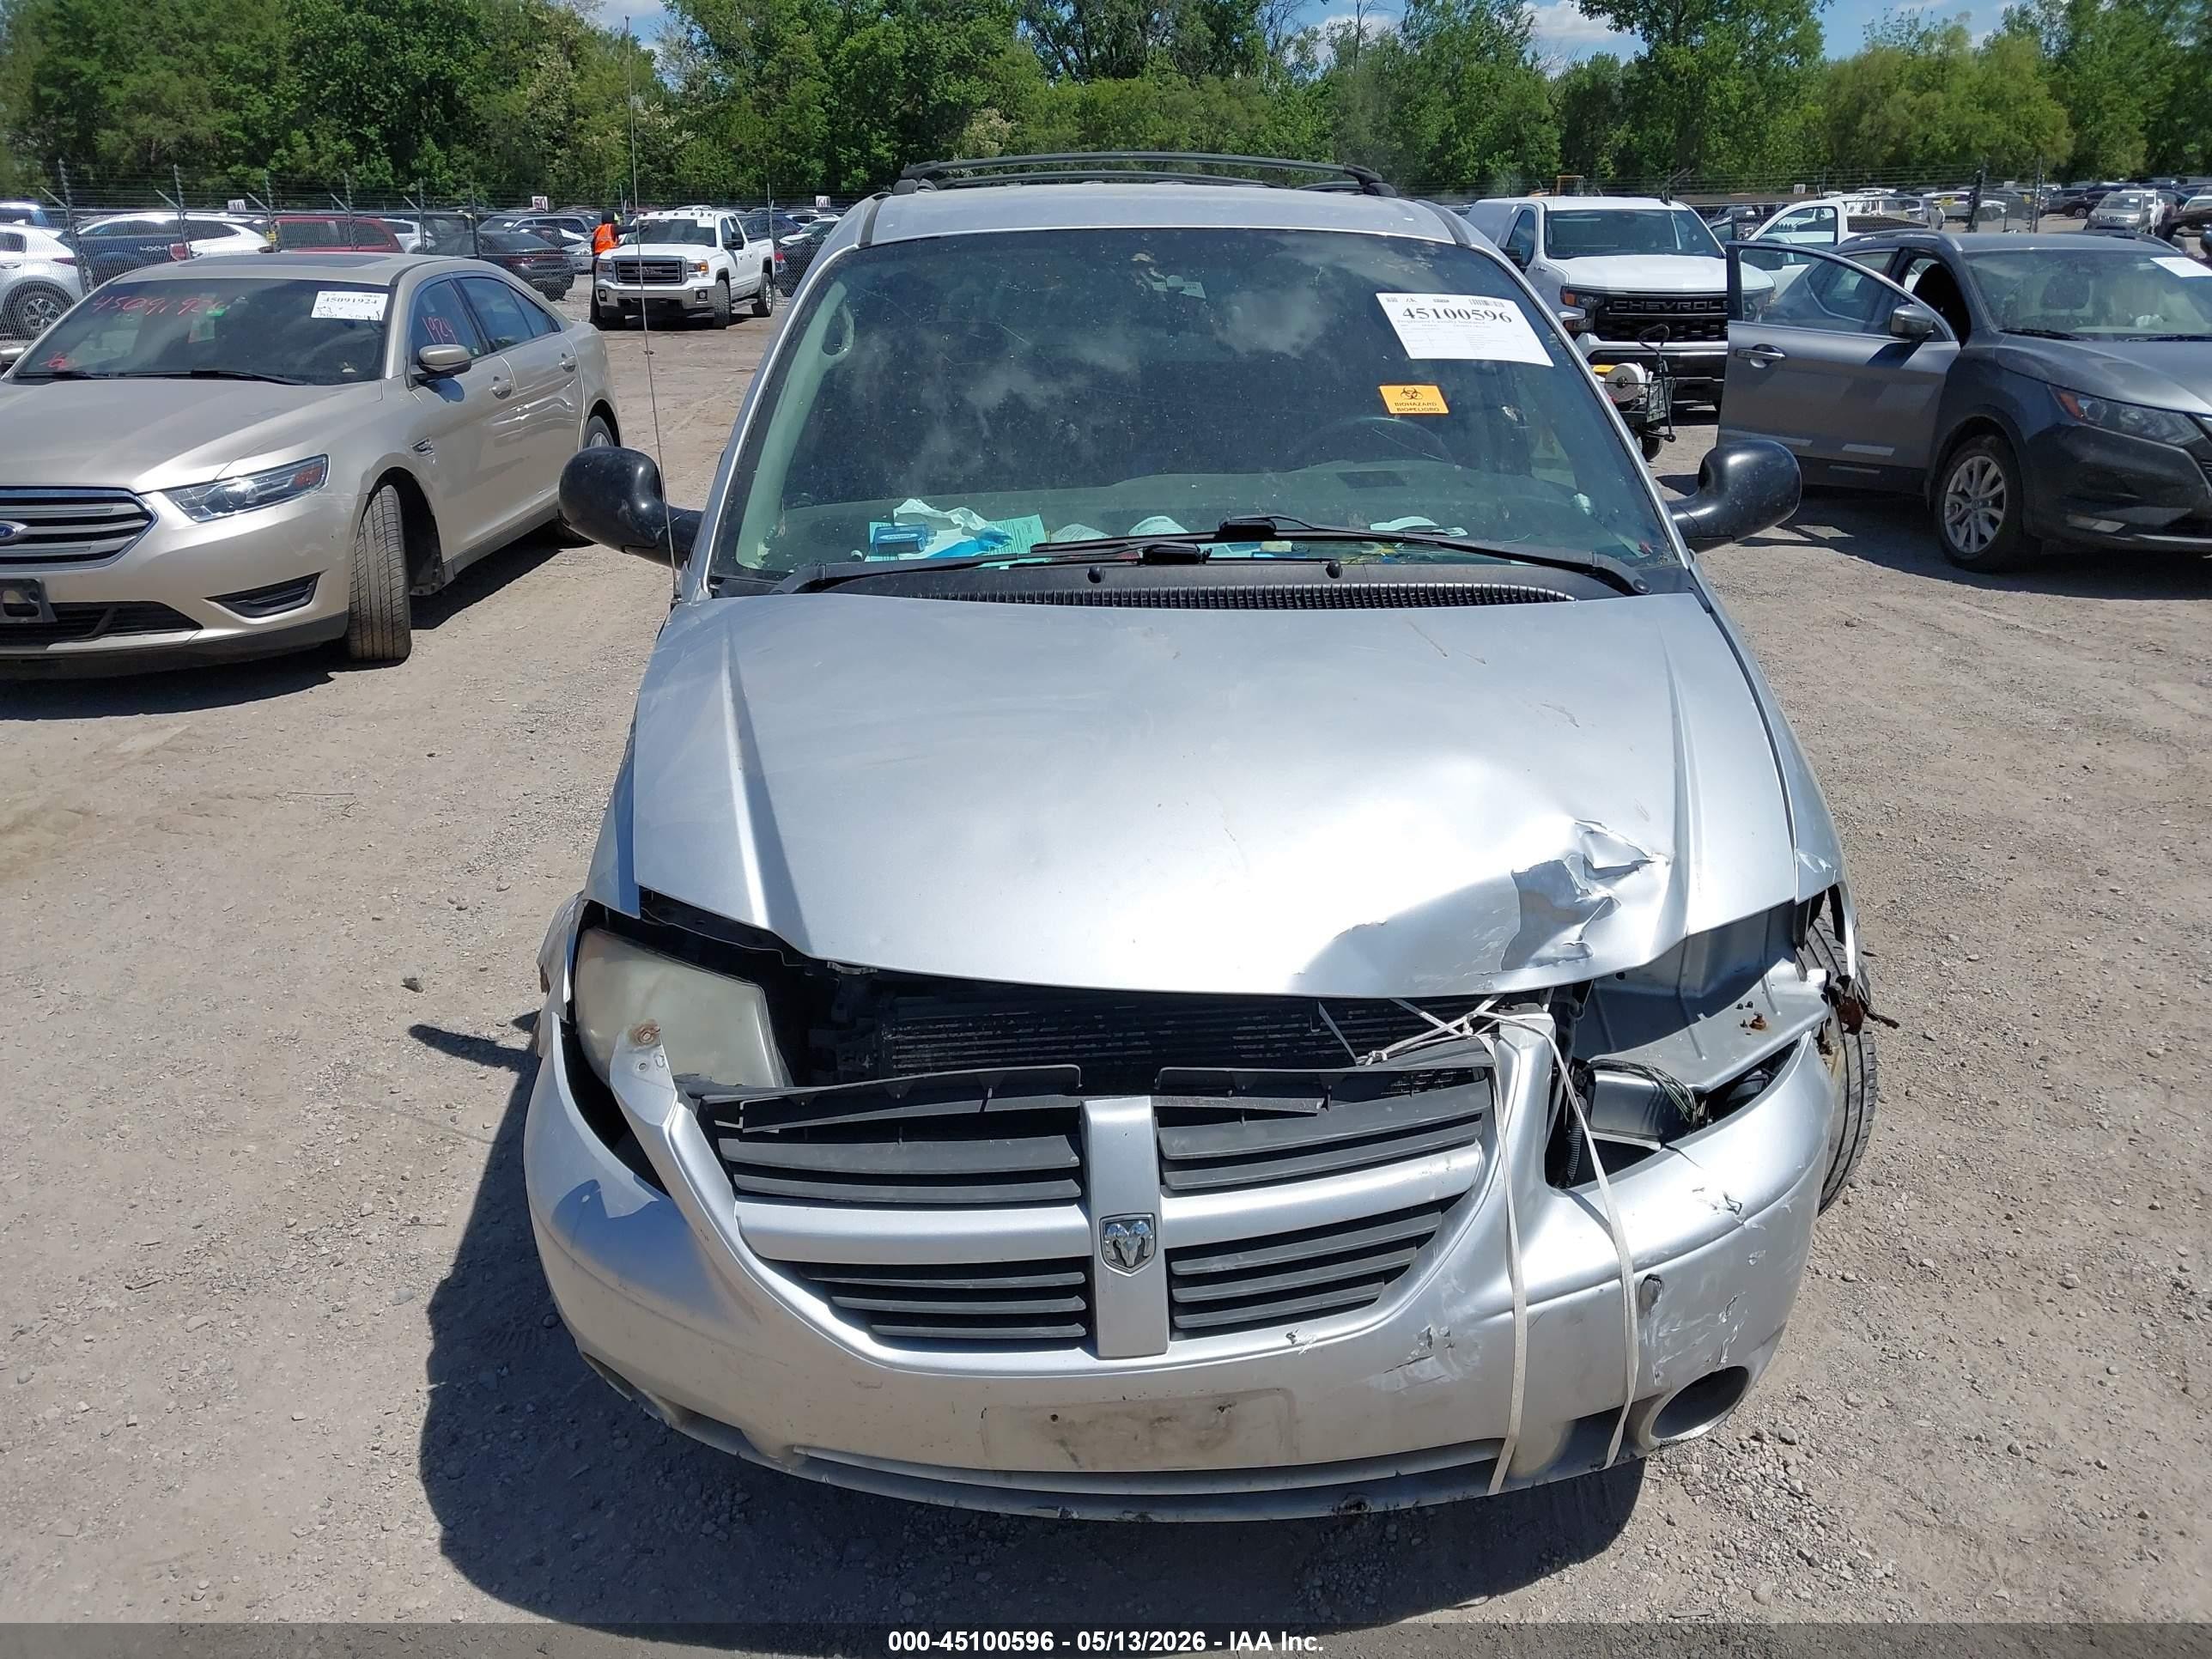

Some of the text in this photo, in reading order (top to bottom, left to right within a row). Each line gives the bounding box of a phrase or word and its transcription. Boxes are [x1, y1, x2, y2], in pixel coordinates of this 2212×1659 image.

[1613, 301, 1729, 310] CHEVROL
[1402, 307, 1512, 324] 45100596
[422, 316, 458, 344] 1924
